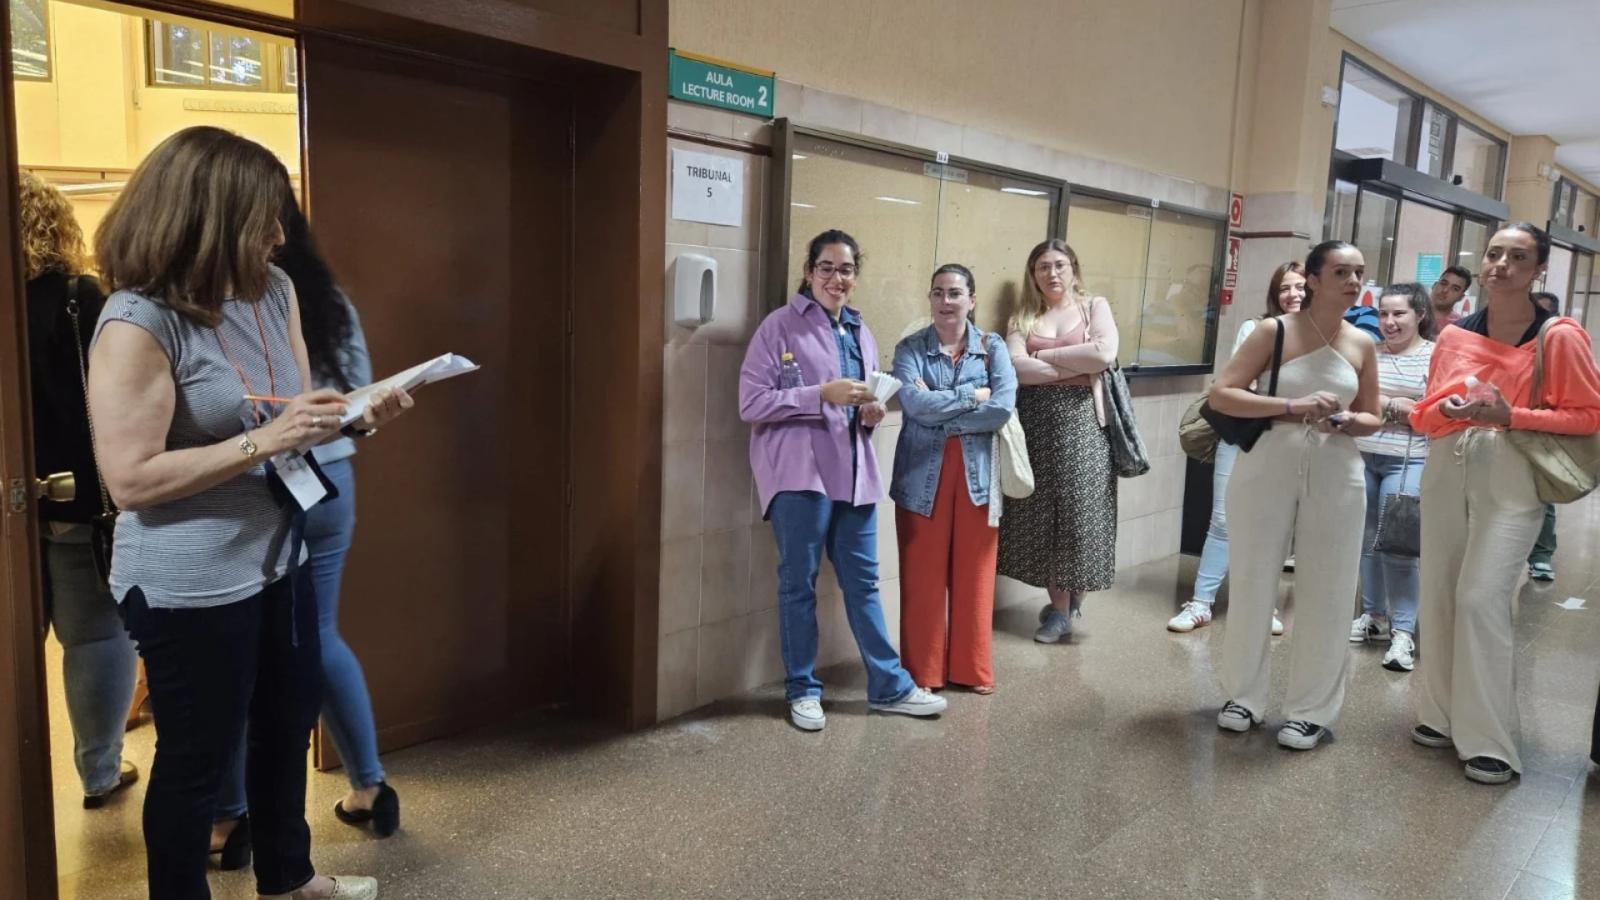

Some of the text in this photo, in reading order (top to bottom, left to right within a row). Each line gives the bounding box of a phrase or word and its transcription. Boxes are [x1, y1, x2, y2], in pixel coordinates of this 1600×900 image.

[706, 71, 733, 88] AULA
[682, 82, 755, 109] LECTURE ROOM
[757, 85, 768, 107] 2
[686, 165, 732, 183] TRIBUNAL
[706, 187, 713, 198] 5
